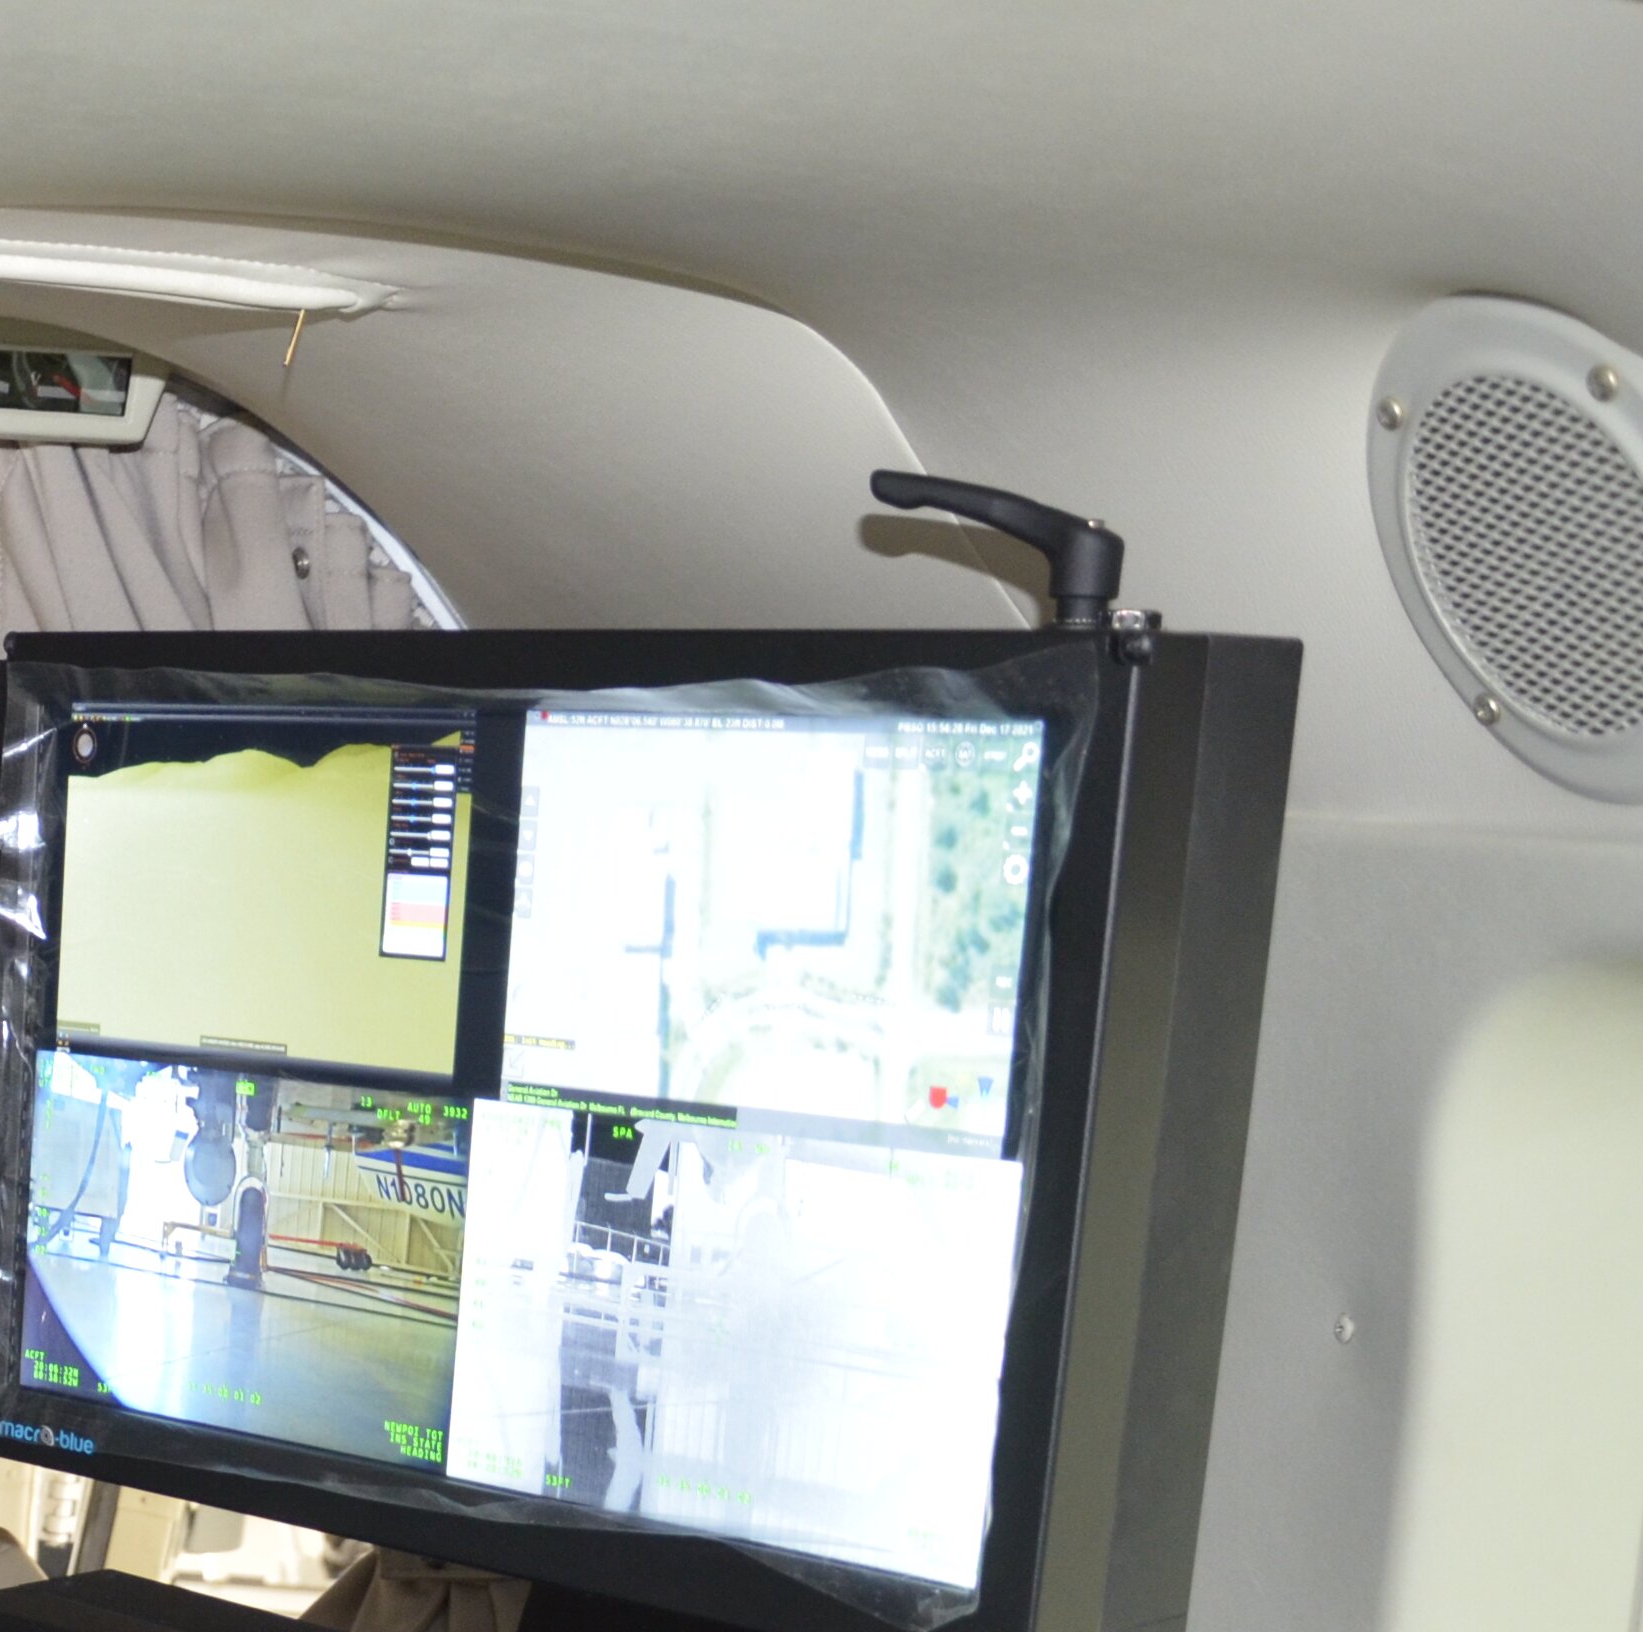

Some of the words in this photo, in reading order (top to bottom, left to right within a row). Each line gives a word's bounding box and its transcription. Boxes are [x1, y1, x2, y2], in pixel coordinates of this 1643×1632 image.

[407, 1102, 432, 1114] AUTO
[612, 1126, 634, 1140] SPA
[24, 1349, 45, 1361] ACFT
